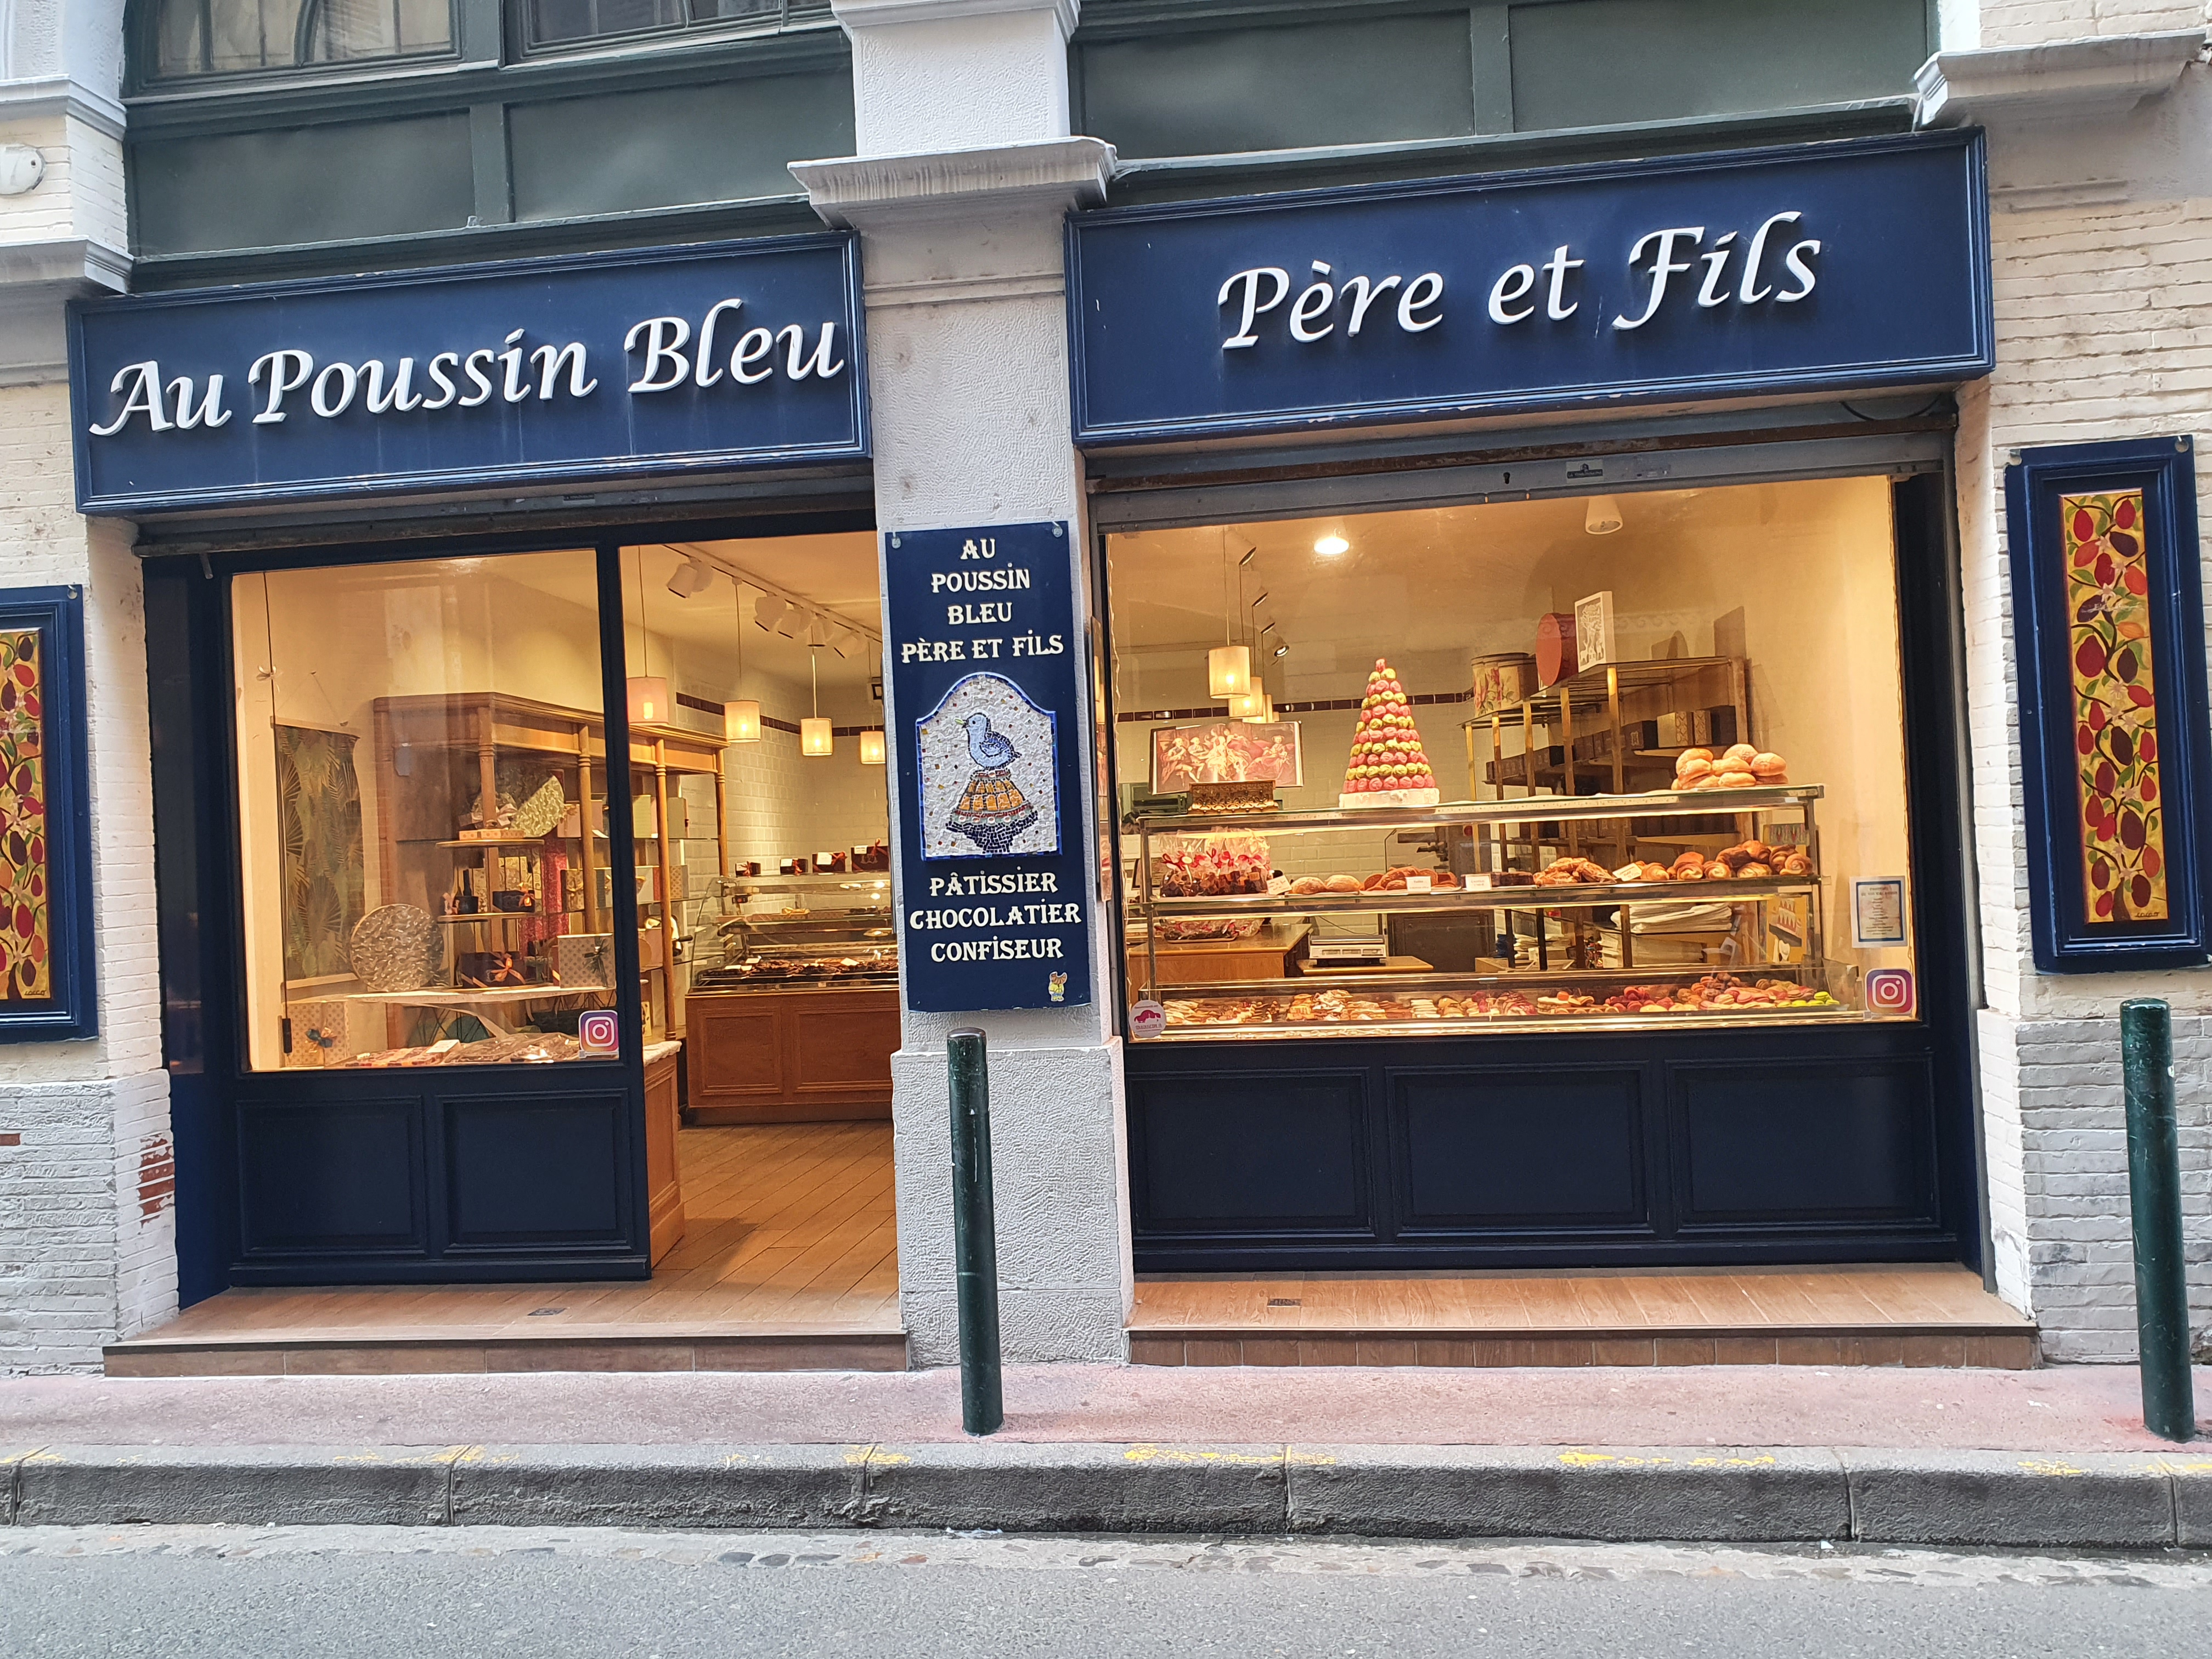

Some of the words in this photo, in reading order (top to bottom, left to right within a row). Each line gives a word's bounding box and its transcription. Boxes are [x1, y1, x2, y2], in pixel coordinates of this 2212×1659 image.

[1218, 260, 1443, 348] Père
[1488, 245, 1584, 323] et
[1612, 211, 1820, 328] Fils
[88, 360, 232, 435] Au
[248, 329, 597, 423] Poussin
[624, 298, 844, 393] Bleu
[960, 538, 995, 560] AU
[948, 602, 1012, 625] BLEU
[901, 637, 966, 663] PÈRE
[972, 639, 1003, 659] ET
